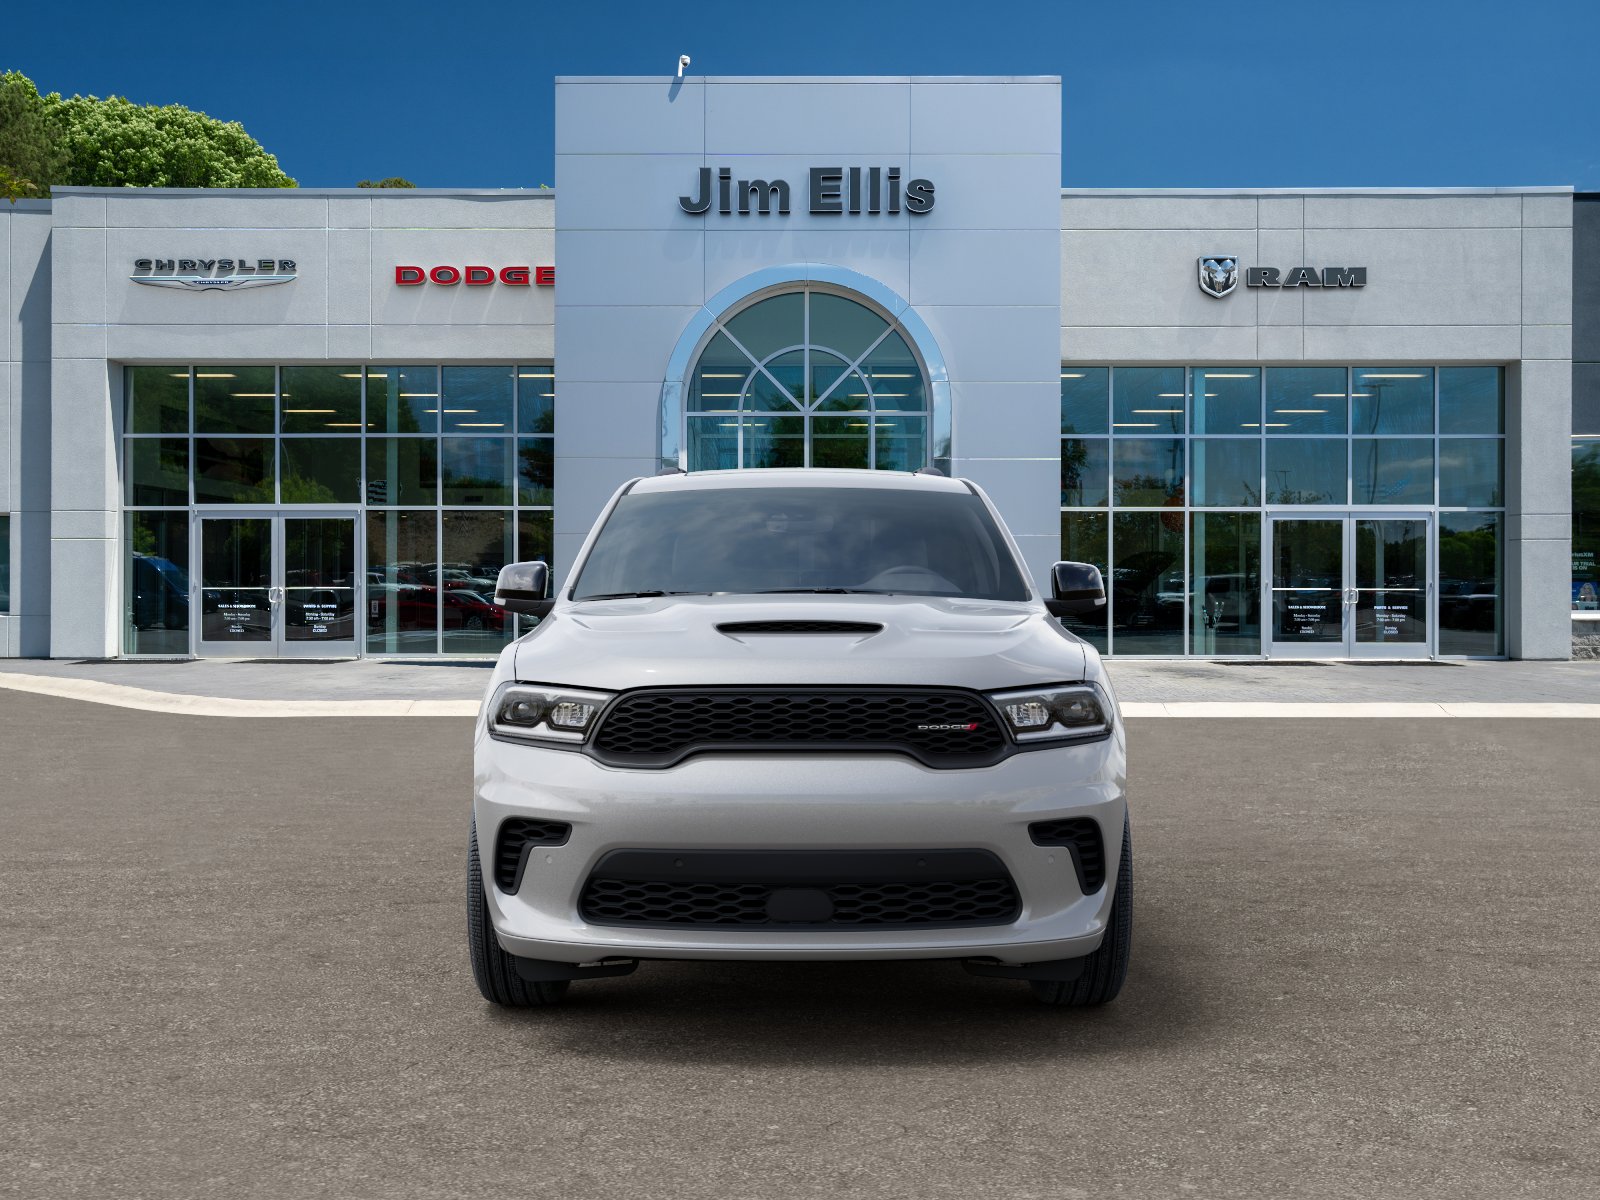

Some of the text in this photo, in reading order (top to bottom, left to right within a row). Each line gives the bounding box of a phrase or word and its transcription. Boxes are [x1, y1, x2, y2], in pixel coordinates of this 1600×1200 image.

[679, 167, 935, 213] Jim Ellis
[134, 259, 297, 271] CHRYSLER
[396, 266, 555, 286] DODGE
[1247, 267, 1367, 287] RAM
